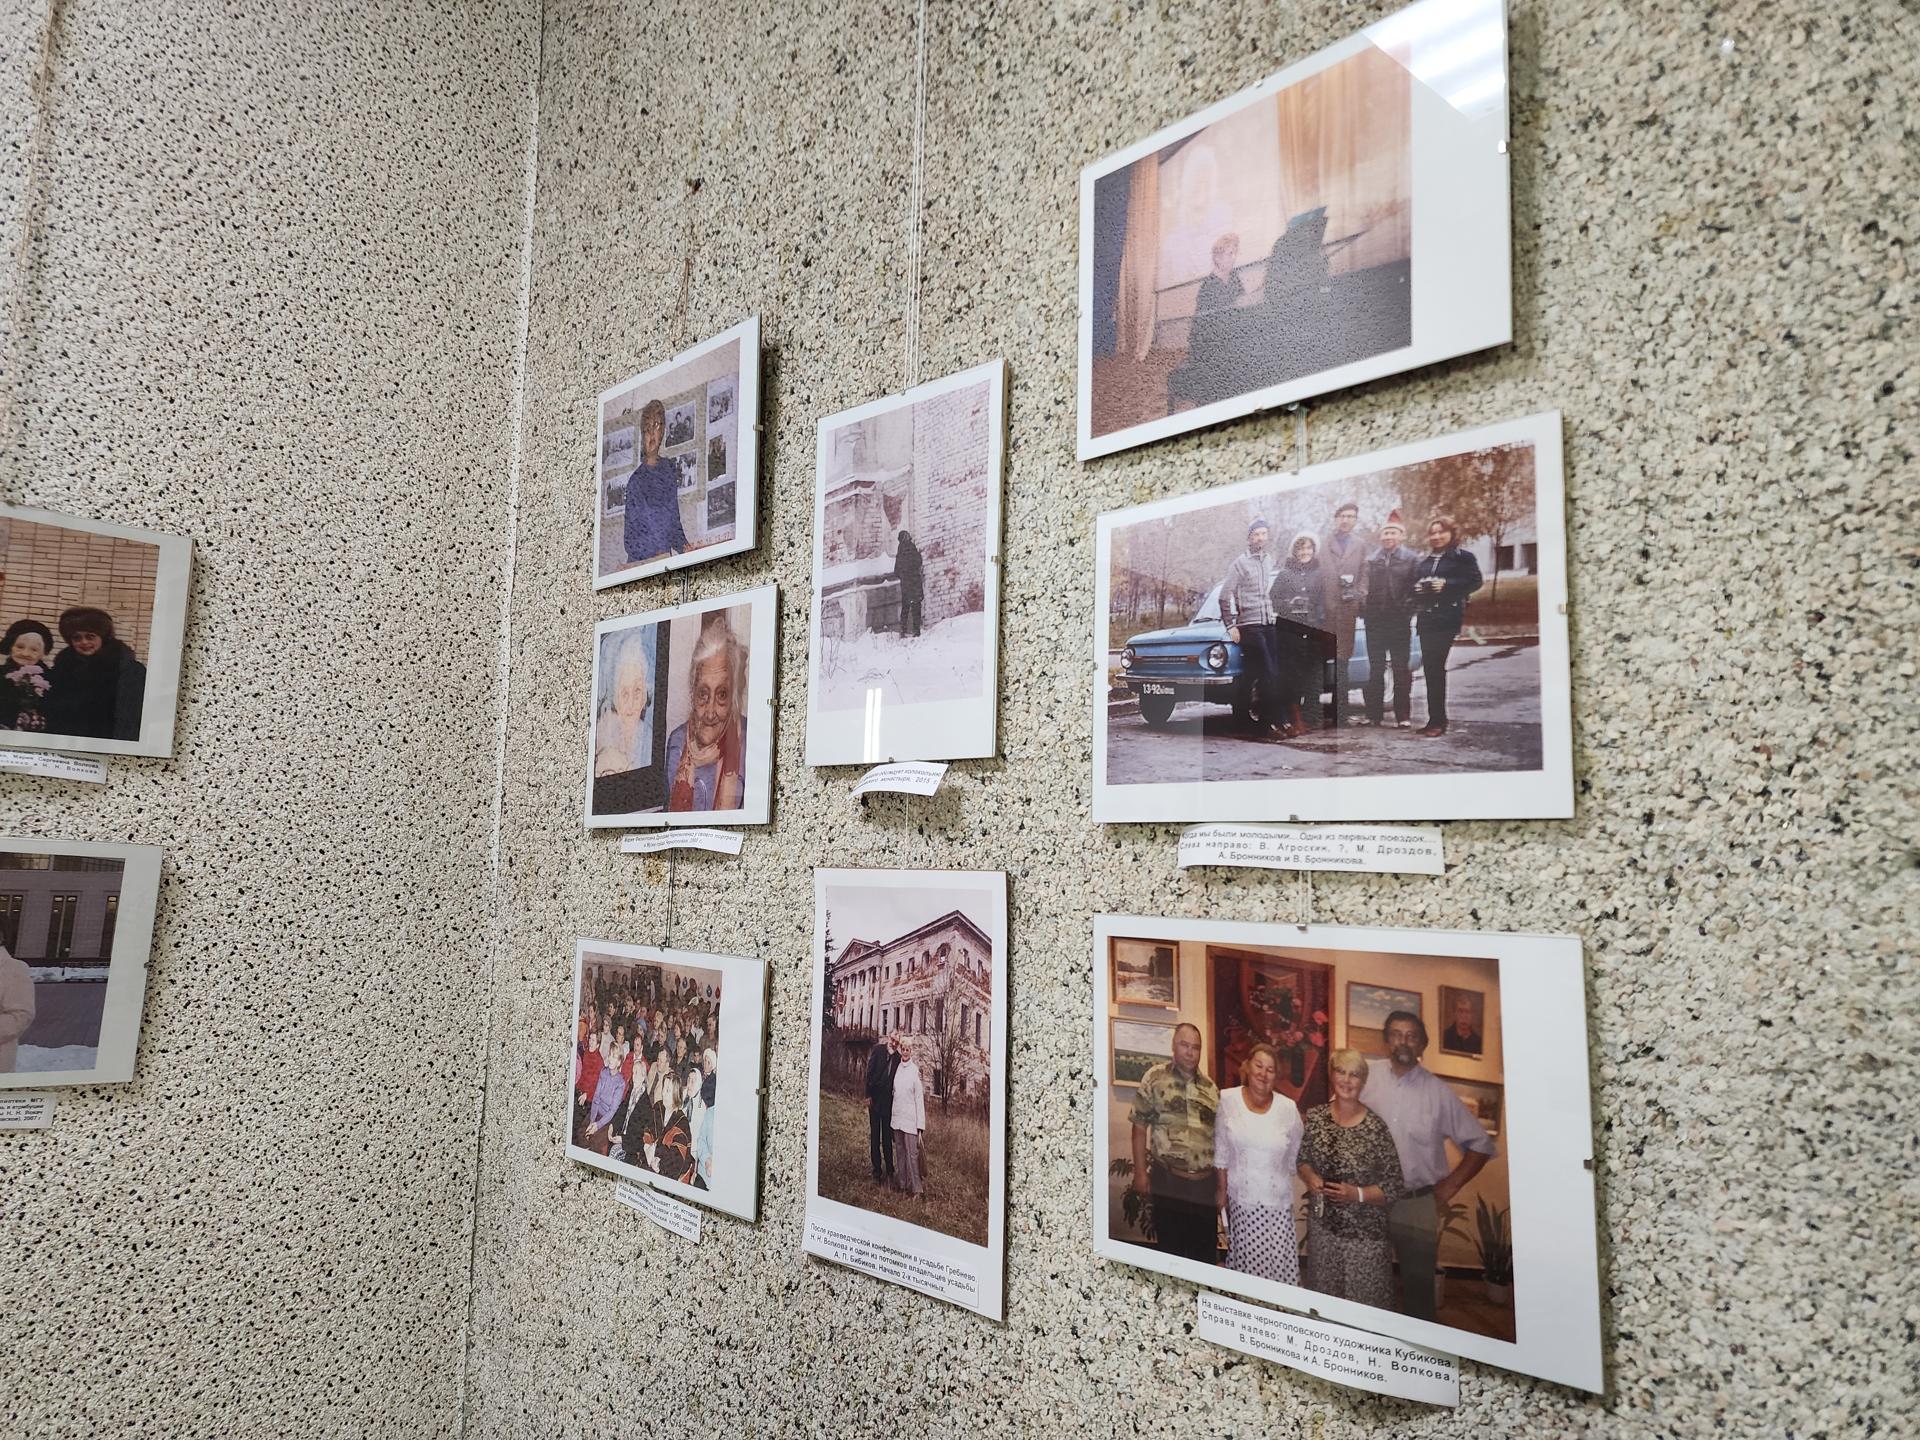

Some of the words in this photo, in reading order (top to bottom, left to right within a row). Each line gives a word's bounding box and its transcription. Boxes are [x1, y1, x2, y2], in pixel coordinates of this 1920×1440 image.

[1213, 829, 1237, 838] были
[1218, 851, 1228, 860] А.
[1230, 851, 1282, 862] Бронников
[1293, 854, 1304, 864] В.
[1260, 842, 1270, 850] В.
[810, 1222, 827, 1234] После
[872, 1243, 912, 1260] конференции
[919, 1257, 945, 1271] усадьбе
[823, 1237, 848, 1251] Волкова
[854, 1247, 870, 1259] один
[879, 1255, 908, 1270] потомков
[908, 1264, 946, 1283] владельцев
[947, 1277, 976, 1293] усадьбы
[850, 1254, 878, 1270] Бибиков.
[878, 1264, 901, 1278] Начало
[1201, 1298, 1212, 1309] На
[1213, 1303, 1252, 1320] выставке
[1254, 1313, 1330, 1342] черноголовского
[1333, 1335, 1392, 1356] художника
[1395, 1347, 1455, 1369] Кубикова.
[1201, 1310, 1235, 1328] Справа
[1241, 1323, 1281, 1342] налево:
[1286, 1334, 1299, 1347] М.
[1304, 1340, 1359, 1365] Дроздов,
[1368, 1356, 1382, 1369] Н.
[1391, 1360, 1456, 1384] Волкова,
[1239, 1333, 1249, 1345] В.
[1250, 1337, 1301, 1361] Бронникова
[1311, 1355, 1321, 1367] А.
[1323, 1359, 1388, 1383] Бронников.
